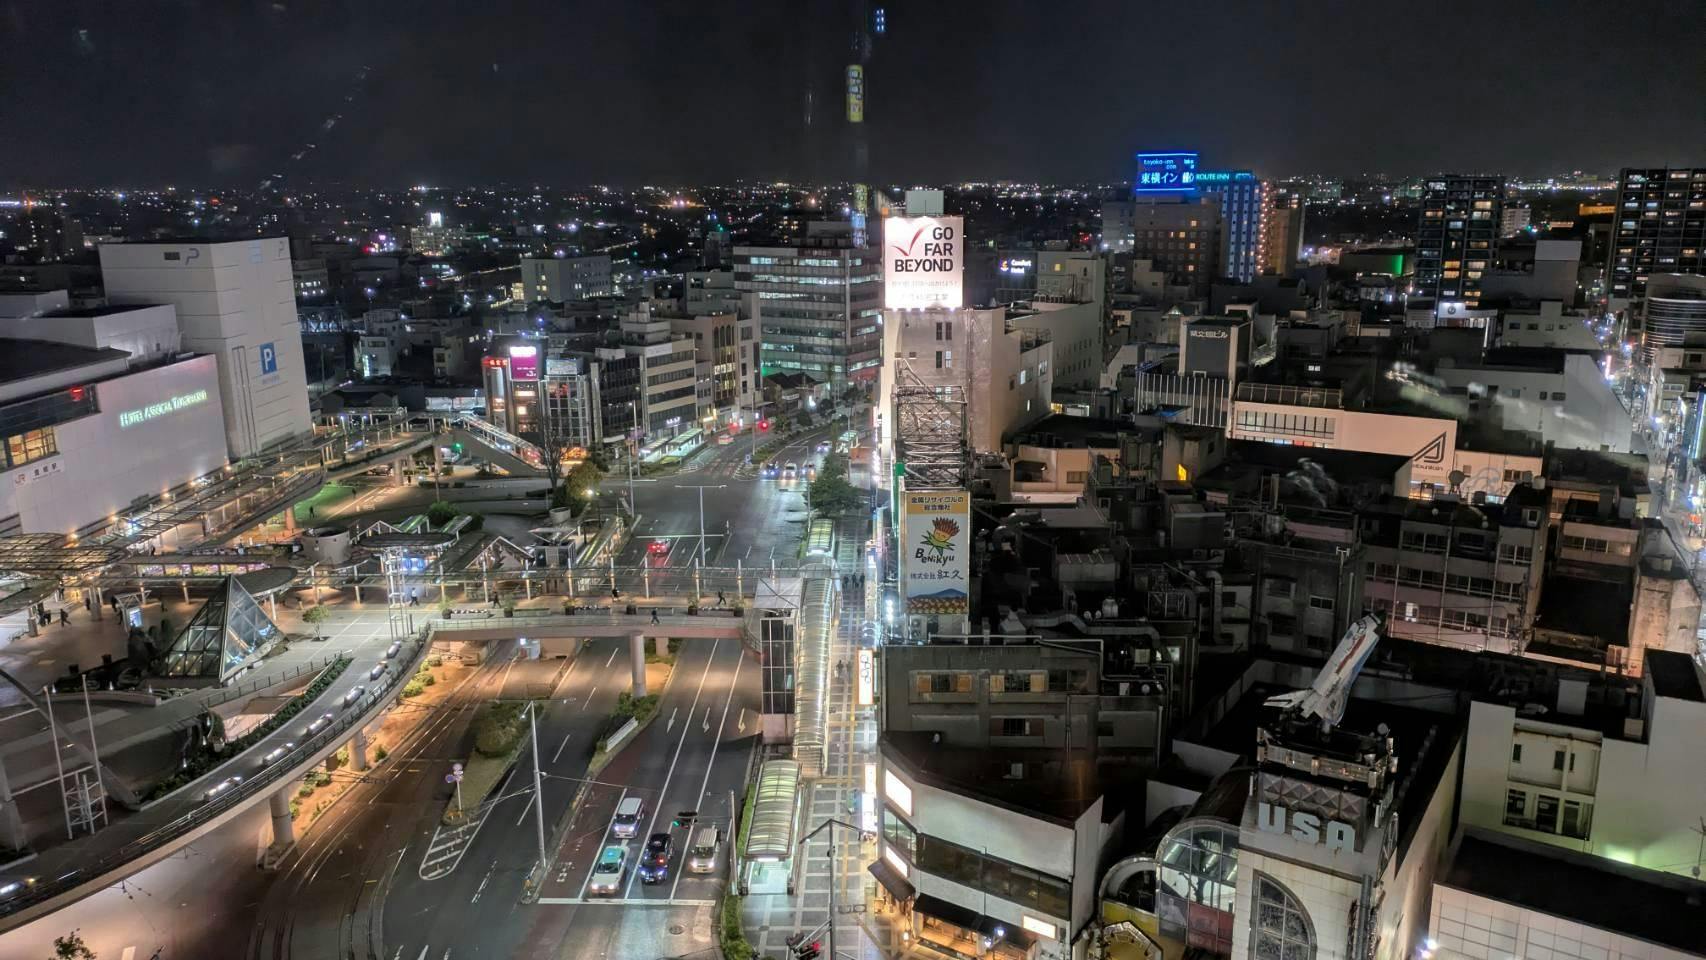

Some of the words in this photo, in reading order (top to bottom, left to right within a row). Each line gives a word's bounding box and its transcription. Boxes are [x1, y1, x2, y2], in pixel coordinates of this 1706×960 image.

[1141, 172, 1178, 184] 東横イン
[933, 227, 953, 240] GO
[925, 243, 953, 256] FAR
[895, 259, 953, 272] BEYOND
[1258, 802, 1356, 854] USA
